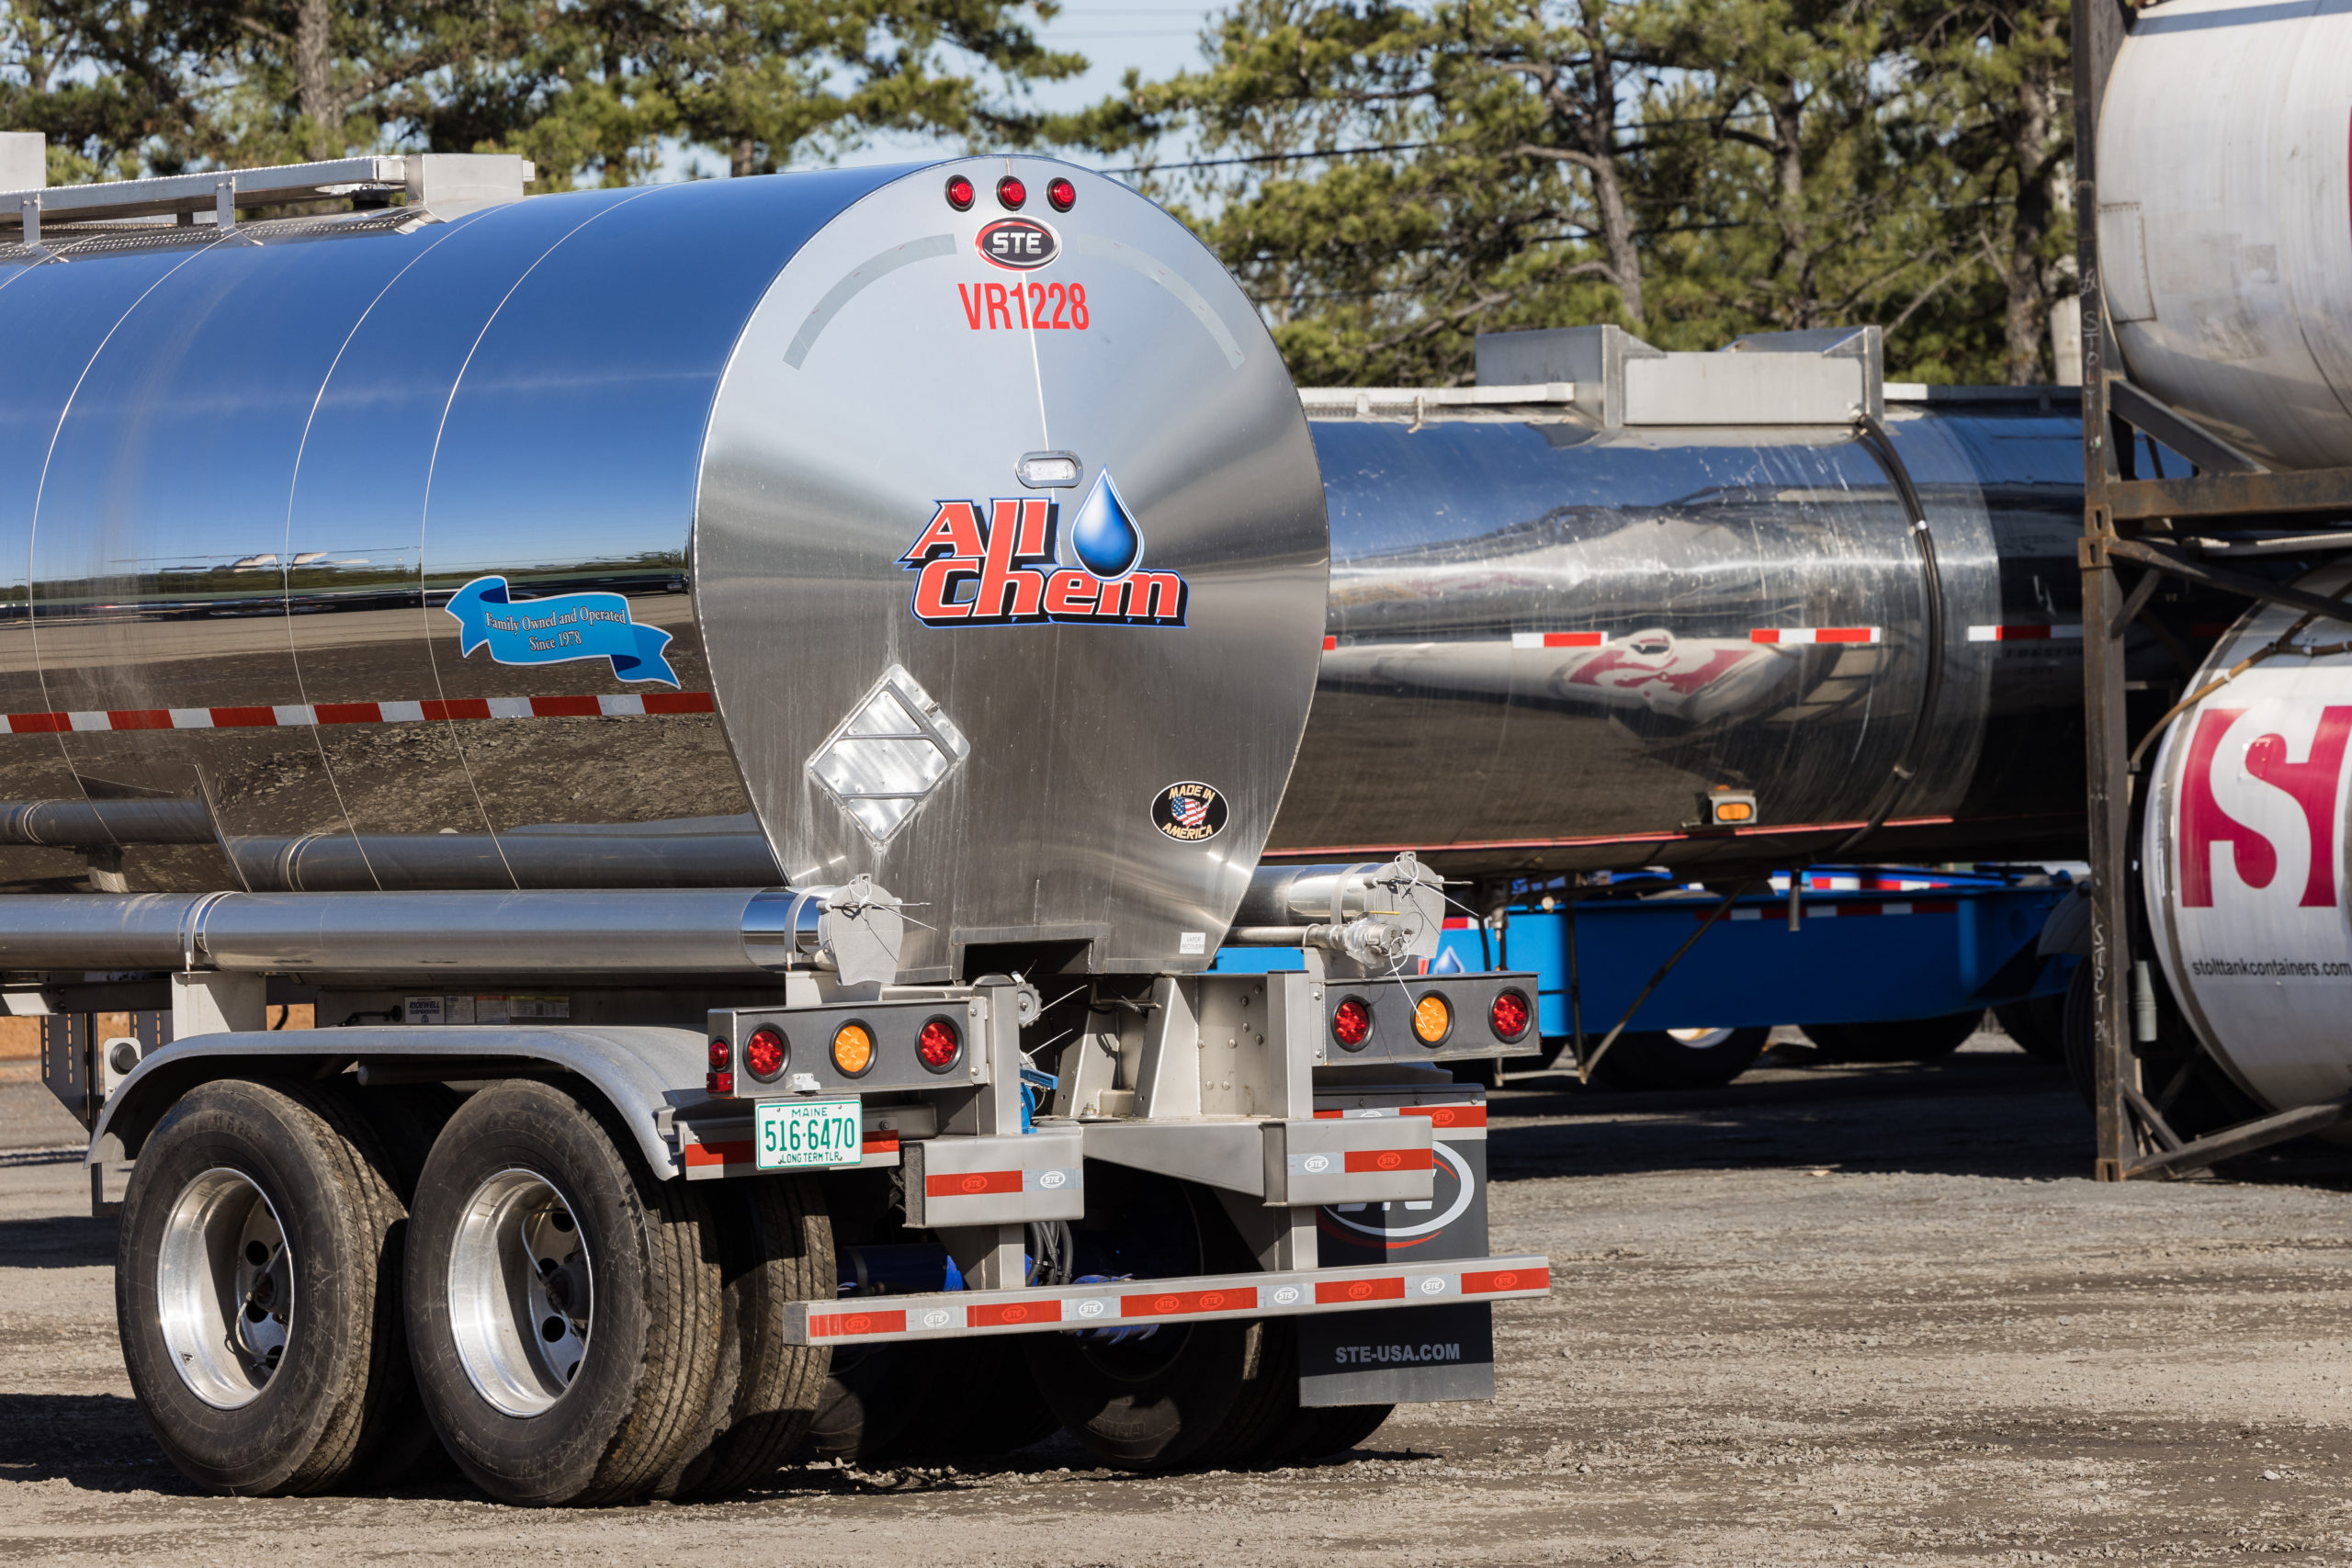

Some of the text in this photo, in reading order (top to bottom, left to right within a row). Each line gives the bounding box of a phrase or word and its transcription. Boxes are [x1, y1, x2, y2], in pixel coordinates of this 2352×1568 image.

[991, 231, 1043, 254] STE
[957, 281, 1090, 331] VR1228
[897, 497, 1058, 564] All
[912, 557, 1188, 627] Chem
[484, 605, 627, 636] Family Owned and Operated
[529, 630, 582, 651] Since 1978
[1168, 784, 1216, 802] MADE IN
[1161, 822, 1214, 840] AMERICA
[2191, 958, 2352, 976] stolttankcontainers.com
[791, 1107, 828, 1118] MAINE
[782, 1151, 840, 1164] LONG TERM TLR
[1335, 1343, 1460, 1363] STE-USA.COM
